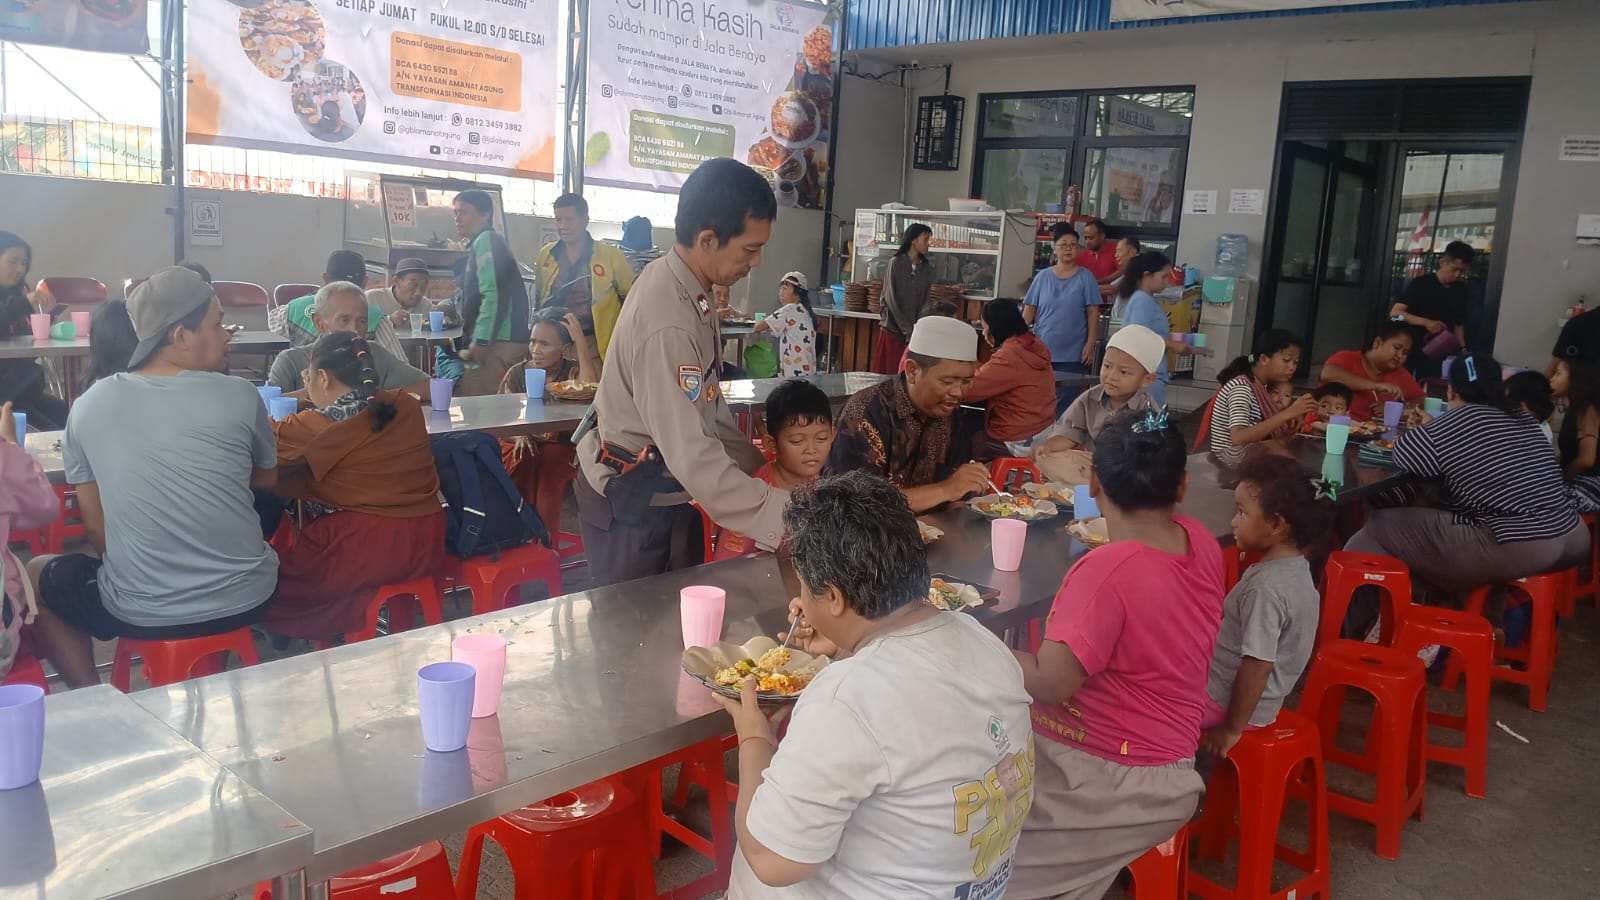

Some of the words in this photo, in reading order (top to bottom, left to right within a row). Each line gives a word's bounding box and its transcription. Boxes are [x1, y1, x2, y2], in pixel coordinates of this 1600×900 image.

[380, 2, 416, 21] JUMAT
[430, 13, 460, 30] PUKUL
[464, 19, 486, 35] 12.00
[490, 24, 506, 38] S/D
[509, 28, 545, 46] SELESAI
[703, 2, 763, 40] Kasih
[608, 14, 645, 35] Sudah
[649, 28, 689, 48] mampir
[693, 34, 702, 49] di
[704, 39, 725, 54] Jala
[729, 44, 765, 65] Benaya
[396, 36, 423, 48] Donasi
[424, 41, 445, 52] dapat
[446, 46, 483, 58] disalurkan
[484, 53, 509, 63] melalui
[618, 44, 640, 54] Dengan
[681, 58, 694, 67] JALA
[396, 59, 411, 68] BCA
[413, 62, 431, 71] 6430
[618, 56, 632, 64] turut
[414, 72, 448, 85] YAYASAN
[448, 80, 478, 90] AMANAT
[480, 84, 503, 94] AGUNG
[396, 82, 451, 97] TRANSFORMASI
[452, 91, 488, 103] INDONESIA
[384, 106, 399, 115] Info
[401, 108, 420, 118] lebih
[421, 110, 443, 122] lanjut
[633, 114, 654, 124] Donasi
[466, 117, 484, 127] 0812
[486, 120, 503, 129] 3459
[505, 122, 522, 132] 3882
[484, 152, 504, 161] Agung
[647, 147, 674, 157] YAYASAN
[394, 212, 410, 221] 10K
